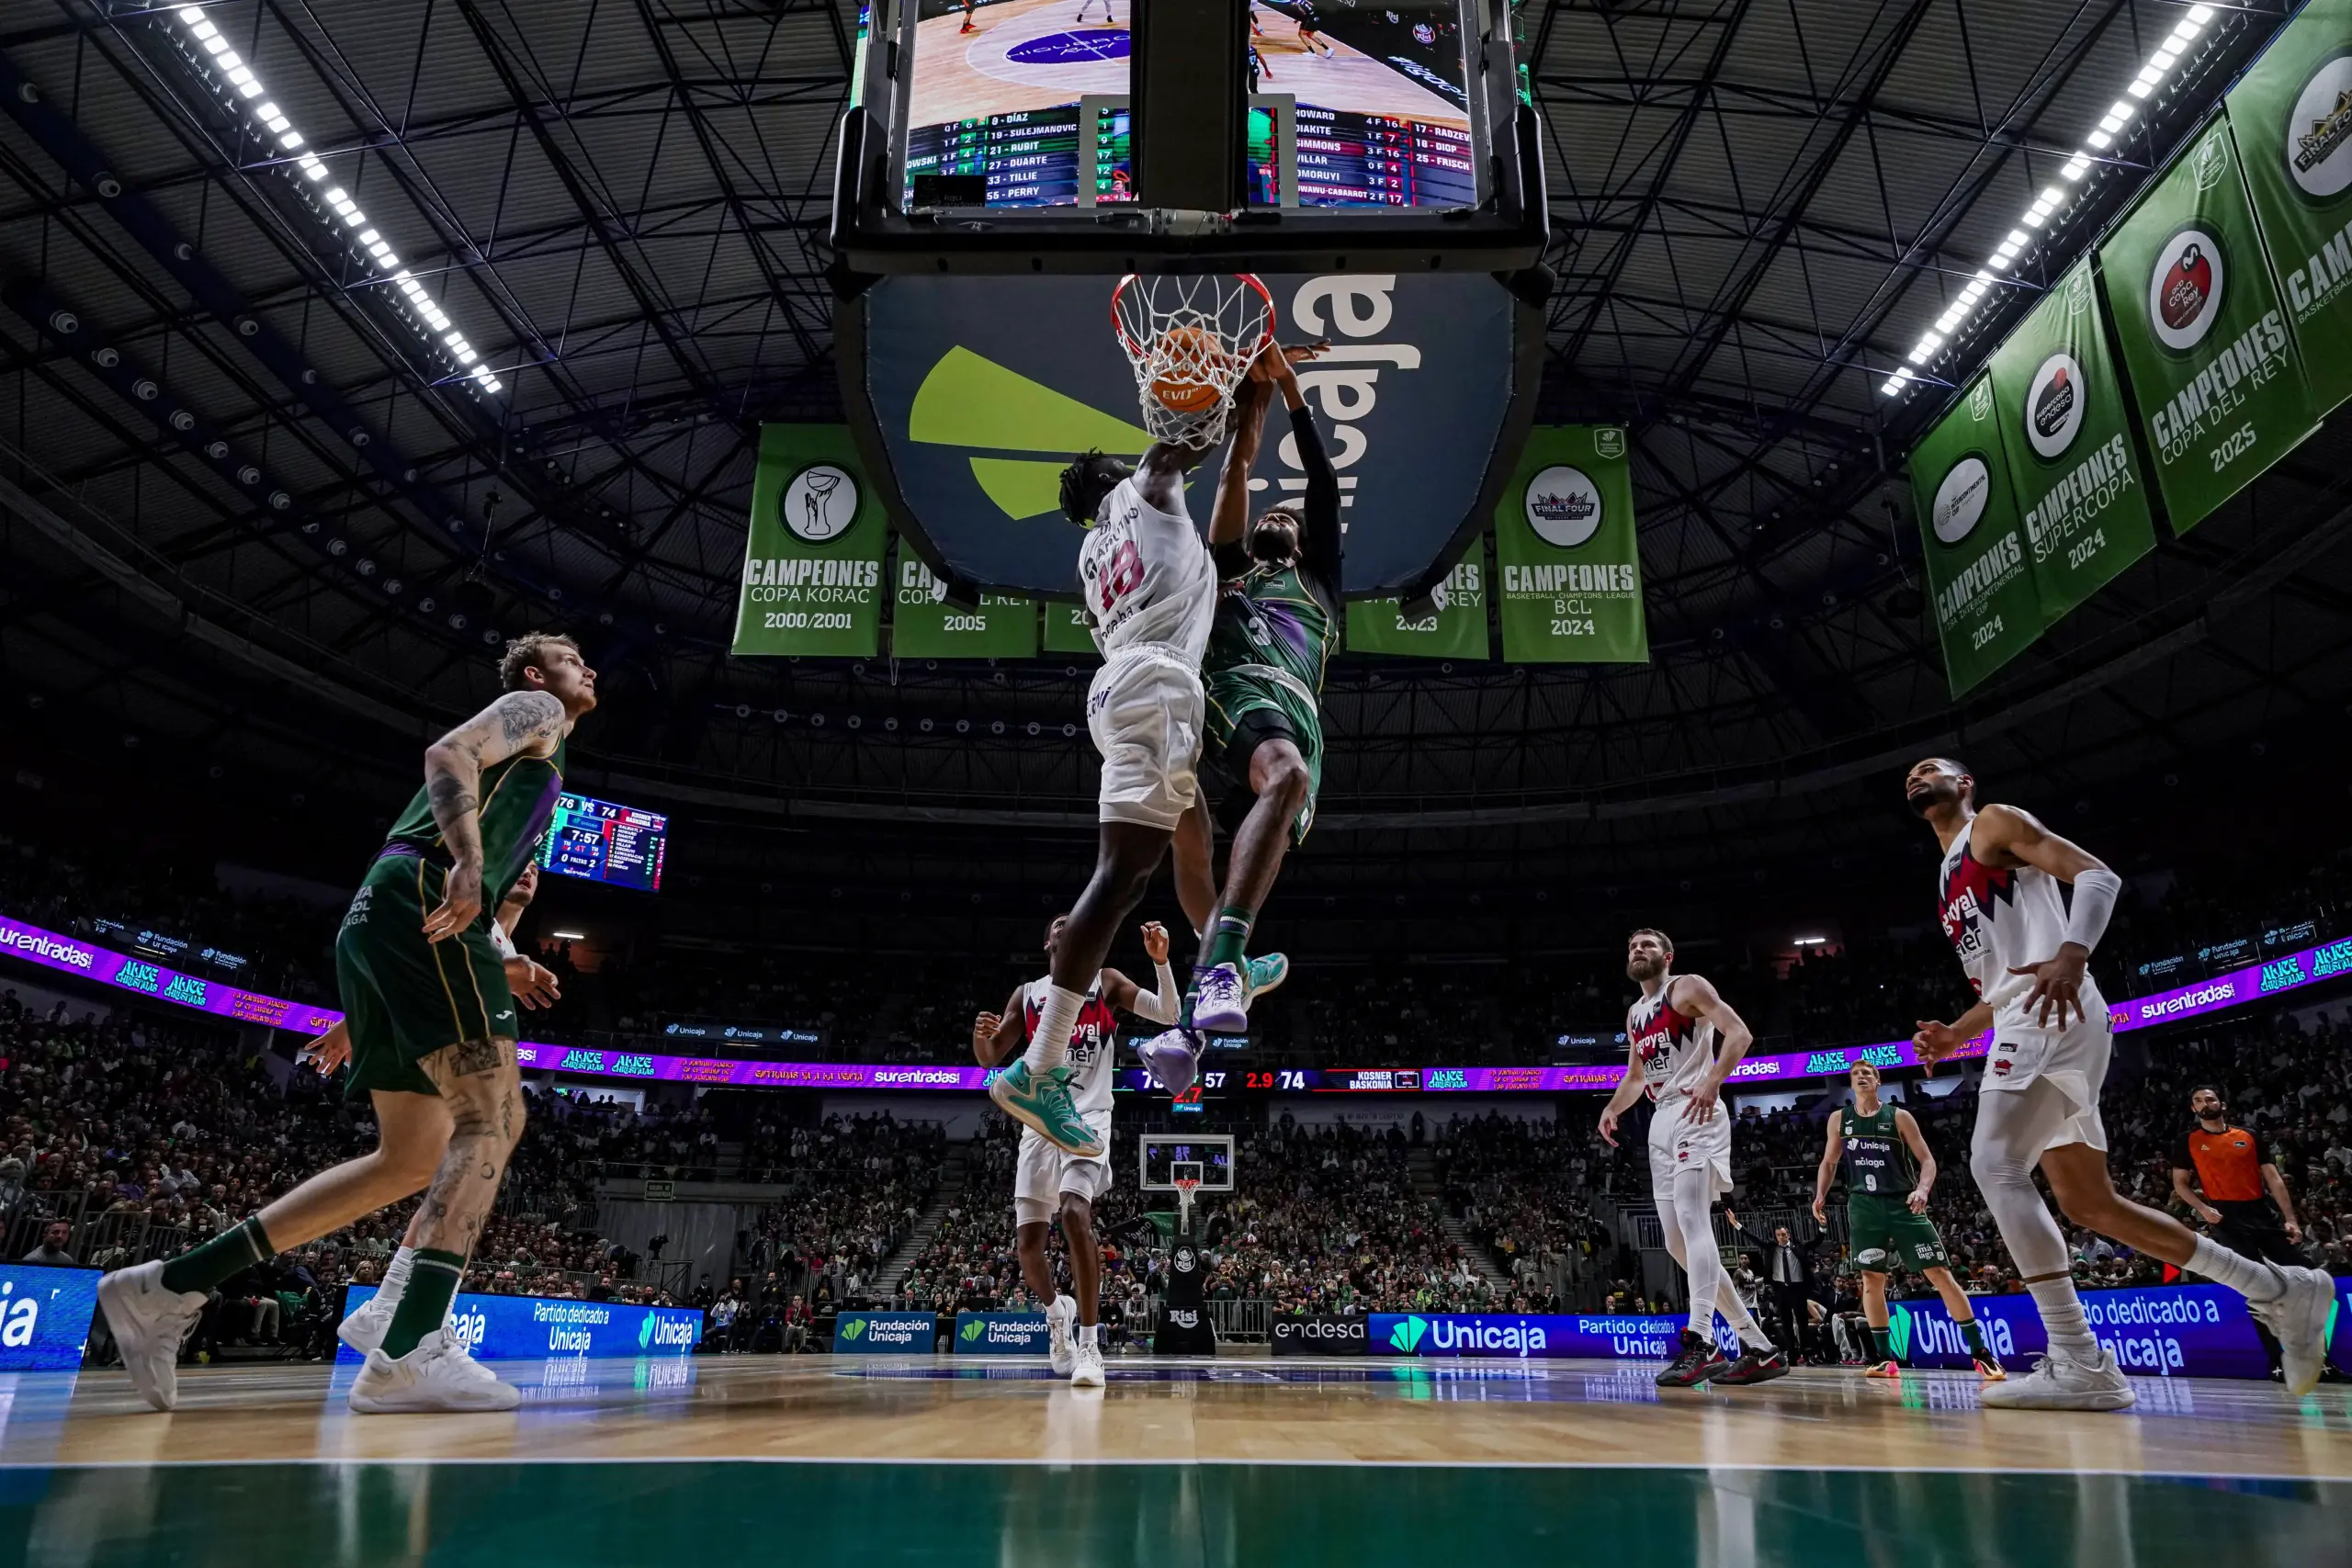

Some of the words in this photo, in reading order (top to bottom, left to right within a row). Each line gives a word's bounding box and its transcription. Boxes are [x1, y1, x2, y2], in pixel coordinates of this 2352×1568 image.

[1007, 112, 1029, 123] DÍAZ
[1295, 108, 1336, 121] HOWARD
[1385, 119, 1398, 128] 16
[966, 121, 972, 130] 6
[991, 131, 1002, 141] 19
[1010, 123, 1077, 138] SULEJMANOVIC
[1415, 123, 1426, 133] 17
[1101, 136, 1108, 145] 9
[1389, 134, 1396, 143] 7
[964, 150, 970, 158] 4
[989, 147, 1001, 156] 21
[1011, 141, 1040, 152] RUBIT
[1295, 140, 1341, 152] SIMMONS
[1367, 147, 1374, 155] 3
[1386, 149, 1400, 158] 16
[1436, 143, 1457, 152] DIOP
[2299, 128, 2335, 165] FINAL
[1097, 151, 1111, 160] 17
[1417, 154, 1430, 164] 25
[989, 162, 1001, 171] 27
[1011, 156, 1047, 167] DUARTE
[1097, 166, 1110, 175] 12
[1296, 154, 1328, 164] VILLAR
[1368, 162, 1374, 170] 0
[1391, 164, 1397, 173] 4
[988, 176, 1001, 186] 33
[1010, 172, 1037, 183] TILLIE
[1099, 182, 1106, 190] 4
[1369, 177, 1374, 186] 3
[1391, 179, 1398, 188] 2
[1007, 187, 1040, 198] PERRY
[1389, 195, 1402, 204] 17
[2182, 287, 2199, 307] Rey
[2152, 310, 2286, 449] CAMPEONES
[2036, 386, 2070, 421] supercopa
[2040, 394, 2072, 426] endesa
[2162, 421, 2205, 466] COPA
[2210, 389, 2245, 426] DEL
[2251, 345, 2288, 390] REY
[2211, 421, 2256, 473] 2025
[1951, 474, 1986, 510] INTERCONTINENTAL
[2025, 433, 2127, 544] CAMPEONES
[1951, 505, 1961, 517] CUP
[2034, 468, 2135, 564] SUPERCOPA
[2068, 527, 2106, 570] 2024
[747, 559, 878, 587] CAMPEONES
[1505, 564, 1634, 592] CAMPEONES
[1939, 531, 2021, 625] CAMPEONES
[751, 588, 801, 603] COPA
[806, 588, 870, 604] KORAC
[1448, 592, 1482, 607] REY
[1555, 599, 1591, 614] BCL
[1975, 602, 1988, 617] CUP
[764, 613, 853, 629] 2000/2001
[944, 615, 985, 631] 2005
[1551, 619, 1595, 636] 2024
[1972, 614, 2004, 650] 2024
[559, 797, 575, 809] 76
[581, 801, 595, 813] VS
[601, 807, 617, 818] 74
[571, 830, 599, 845] 7:57
[574, 845, 586, 853] 4T
[570, 856, 588, 865] FALTAS
[588, 860, 596, 868] 2
[153, 933, 188, 950] Fundación
[2212, 939, 2247, 953] Fundación
[216, 951, 246, 964] Fundación
[2152, 955, 2184, 970] Fundación
[119, 960, 160, 982] ALICE
[2262, 957, 2299, 979] ALICE
[115, 975, 158, 993] CHRISTMAS
[169, 975, 207, 997] ALICE
[2260, 970, 2306, 992] CHRISTMAS
[164, 987, 206, 1007] CHRISTMAS
[2141, 983, 2232, 1019] surentradas
[680, 1027, 706, 1036] Unicaja
[737, 1031, 763, 1039] Unicaja
[794, 1032, 818, 1043] Unicaja
[1570, 1037, 1596, 1045] Unicaja
[566, 1049, 604, 1064] ALICE
[1810, 1051, 1845, 1066] ALICE
[1861, 1045, 1897, 1059] ALICE
[560, 1061, 605, 1073] CHRISTMAS
[616, 1055, 653, 1068] ALICE
[1806, 1062, 1850, 1073] CHRISTMAS
[611, 1066, 654, 1077] CHRISTMAS
[875, 1071, 956, 1084] surentradas
[1358, 1071, 1392, 1080] KOSNER
[1431, 1071, 1464, 1082] ALICE
[1205, 1073, 1227, 1088] 57
[1247, 1073, 1273, 1088] 2.9
[1281, 1071, 1305, 1089] 74
[1349, 1080, 1393, 1089] BASKONIA
[1428, 1080, 1468, 1089] CHRISTMAS
[1173, 1087, 1203, 1103] 2.7
[1860, 1141, 1891, 1152] Unicaja
[1865, 1174, 1877, 1192] 9
[534, 1303, 568, 1325] Partido
[568, 1307, 603, 1325] dedicado
[605, 1314, 610, 1325] a
[1170, 1310, 1198, 1324] Risi
[2108, 1295, 2200, 1325] dedicado
[2205, 1299, 2220, 1323] a
[869, 1319, 930, 1331] Fundación
[989, 1321, 1048, 1332] Fundación
[1275, 1319, 1364, 1339] endesa
[1579, 1319, 1636, 1335] Partido
[1639, 1315, 1669, 1335] dedicado
[1670, 1323, 1676, 1334] a
[549, 1326, 592, 1355] Unicaja
[654, 1316, 693, 1352] Unicaja
[869, 1330, 911, 1345] Unicaja
[989, 1332, 1031, 1346] Unicaja
[1431, 1320, 1547, 1358] Unicaja
[1613, 1336, 1667, 1359] Unicaja
[2100, 1330, 2185, 1376] nicaja
